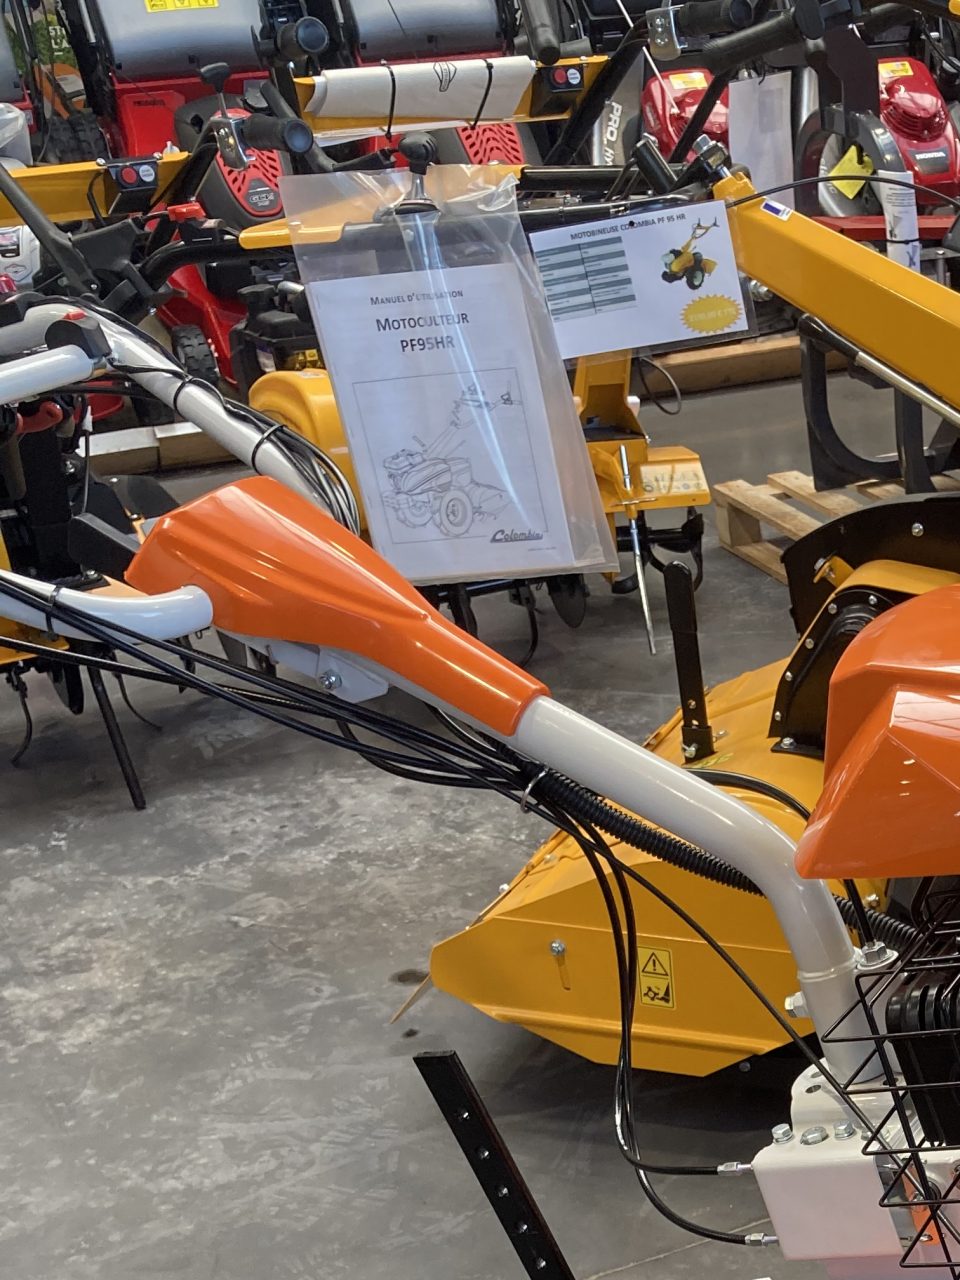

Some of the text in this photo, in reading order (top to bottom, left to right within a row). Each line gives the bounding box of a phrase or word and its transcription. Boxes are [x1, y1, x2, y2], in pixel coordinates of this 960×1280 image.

[570, 225, 619, 241] MOTOBINEUSE
[370, 294, 406, 305] MANUEL
[376, 312, 470, 332] MOTOCULTEUR
[400, 335, 456, 352] PF95HR
[490, 528, 544, 543] Colombia
